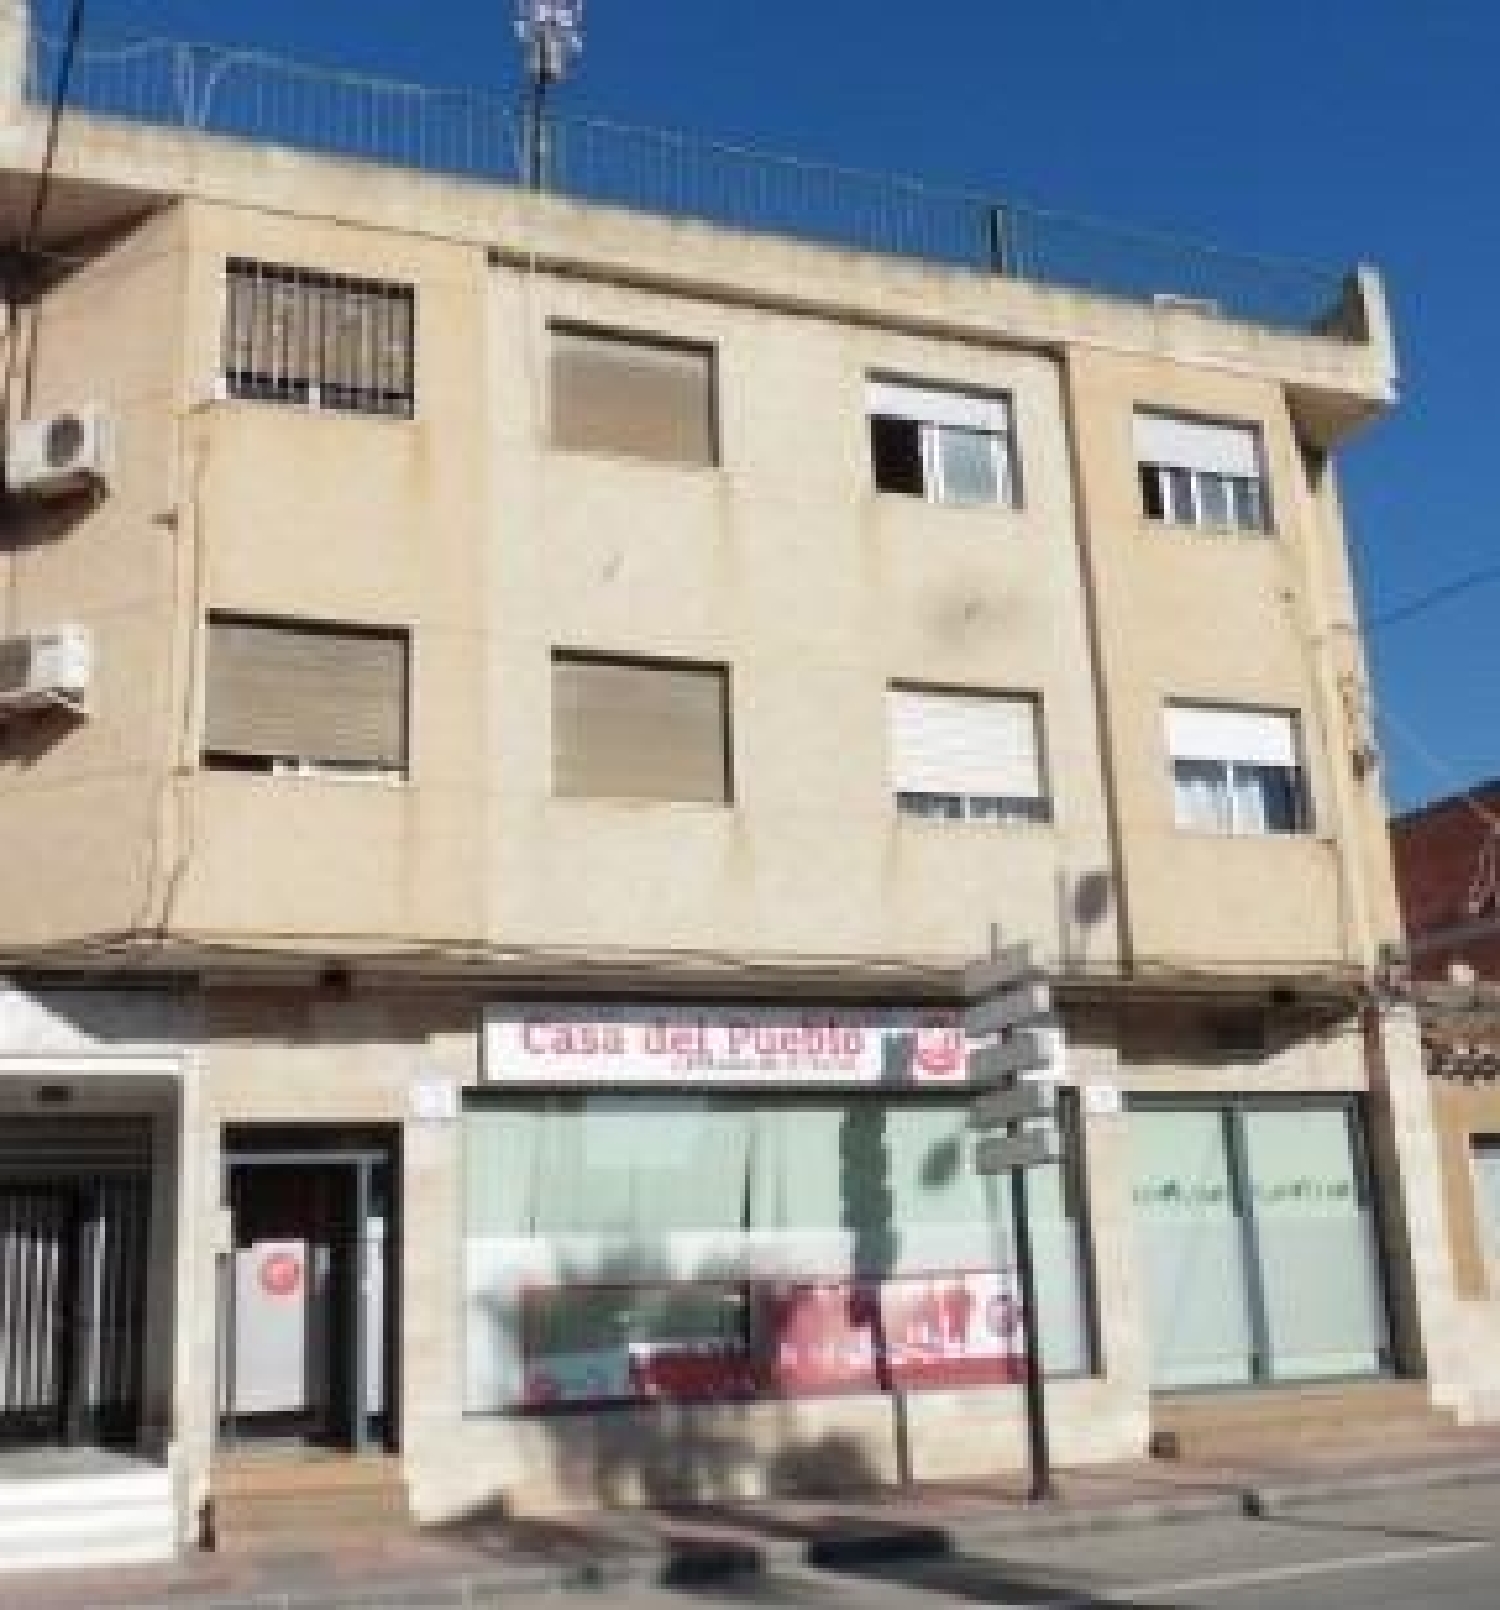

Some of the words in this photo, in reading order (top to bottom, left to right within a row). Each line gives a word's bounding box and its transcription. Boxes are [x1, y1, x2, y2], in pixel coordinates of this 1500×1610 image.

[522, 1016, 623, 1055] Casa
[645, 1015, 705, 1055] del
[728, 1016, 866, 1055] Pueblo
